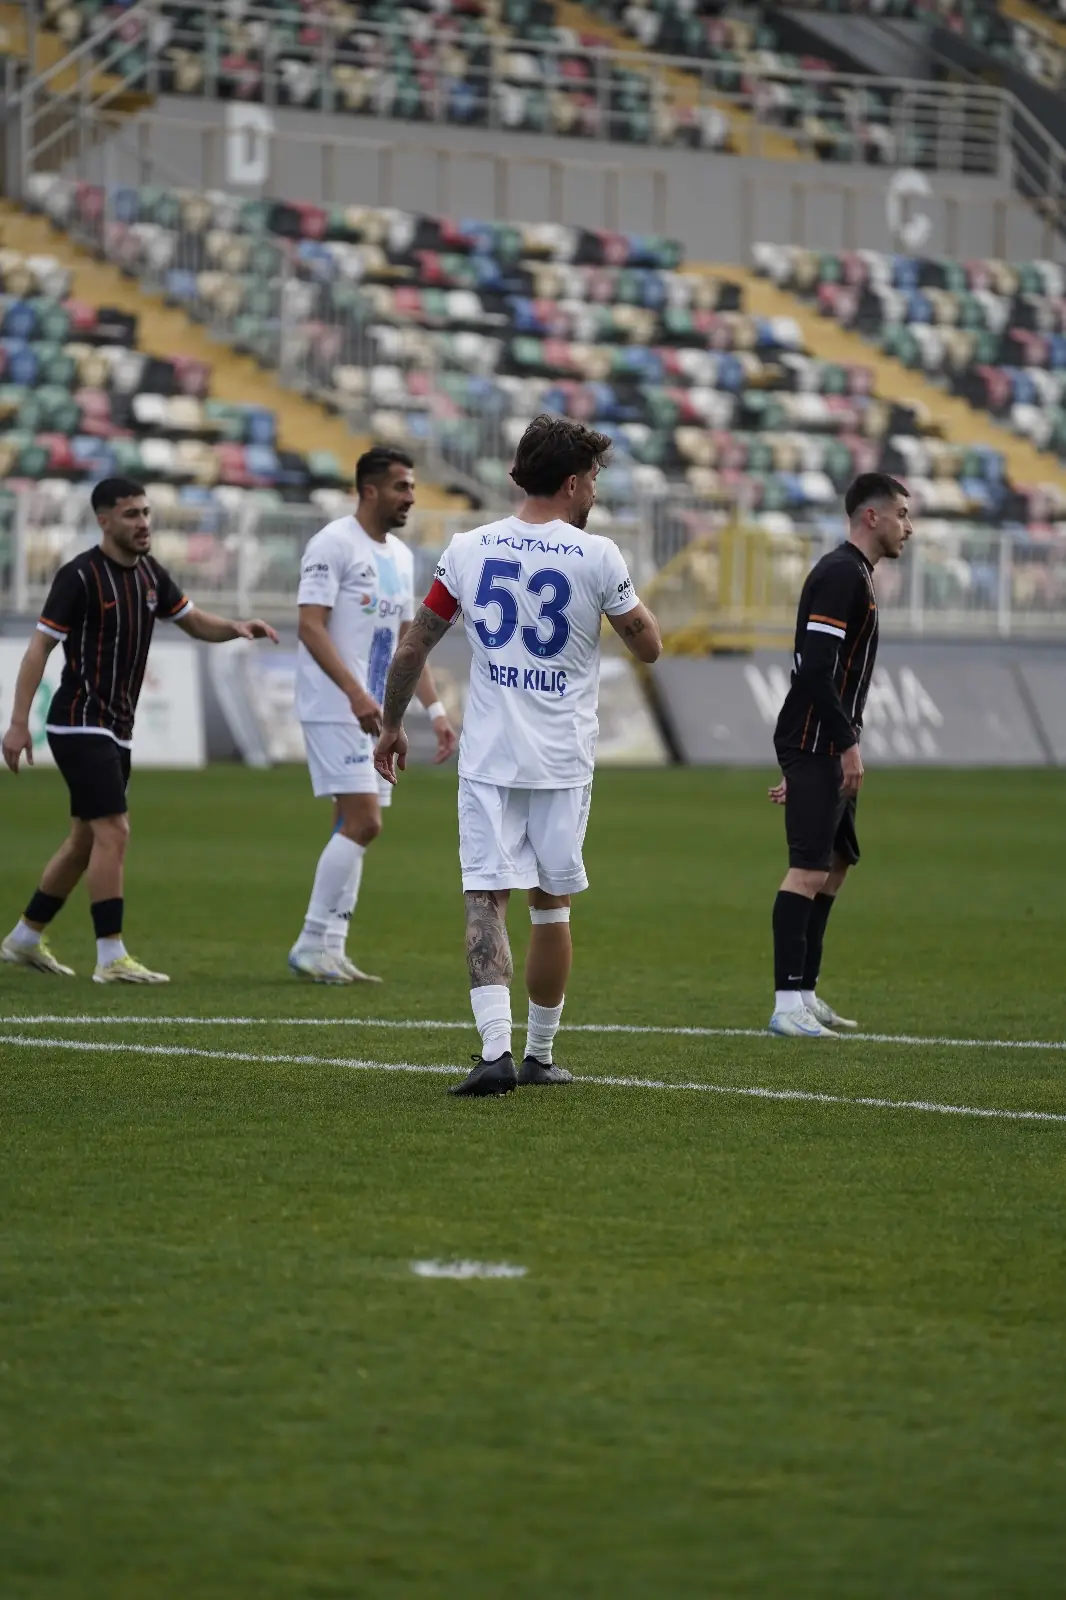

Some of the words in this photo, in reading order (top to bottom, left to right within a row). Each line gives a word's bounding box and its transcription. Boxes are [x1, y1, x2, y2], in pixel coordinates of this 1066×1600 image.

[226, 102, 275, 185] D
[473, 557, 573, 659] 53
[523, 668, 567, 697] KILIÇ
